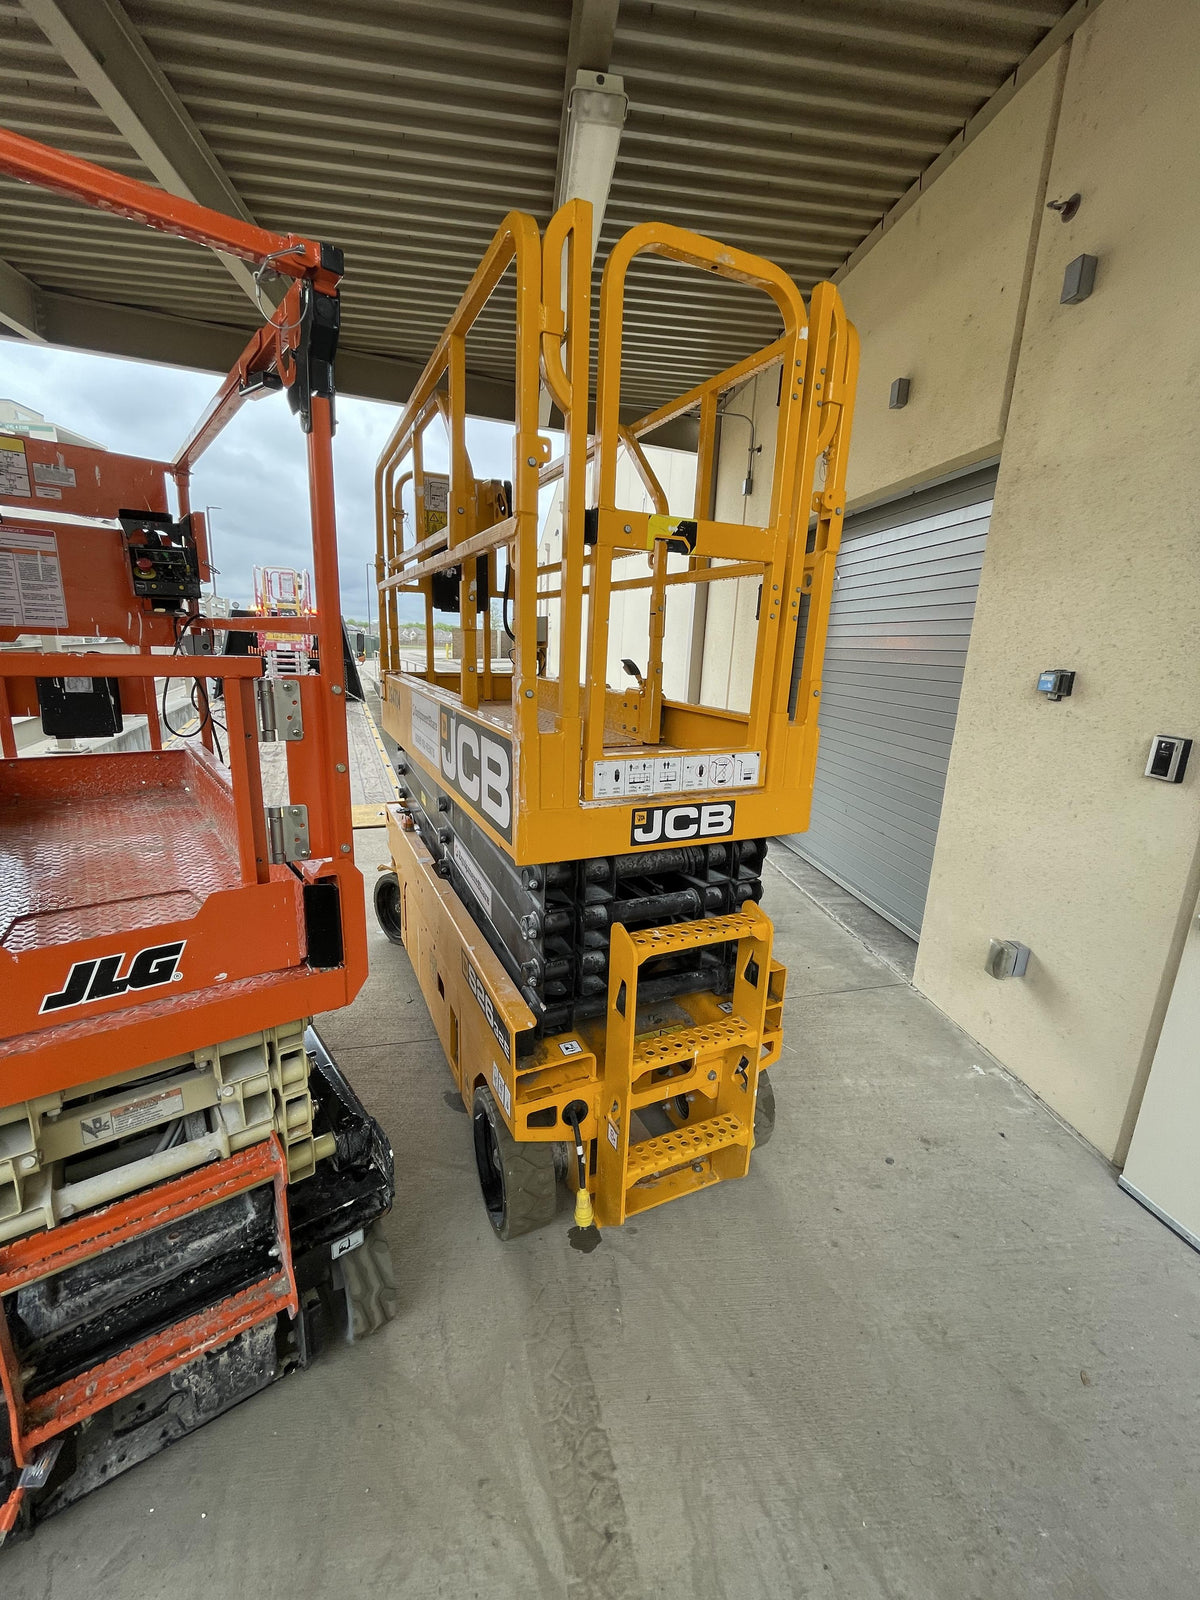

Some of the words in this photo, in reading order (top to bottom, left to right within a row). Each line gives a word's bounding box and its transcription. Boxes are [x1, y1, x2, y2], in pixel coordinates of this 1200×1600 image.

[441, 717, 510, 829] JCB
[633, 804, 733, 843] JCB
[38, 939, 188, 1015] JLG
